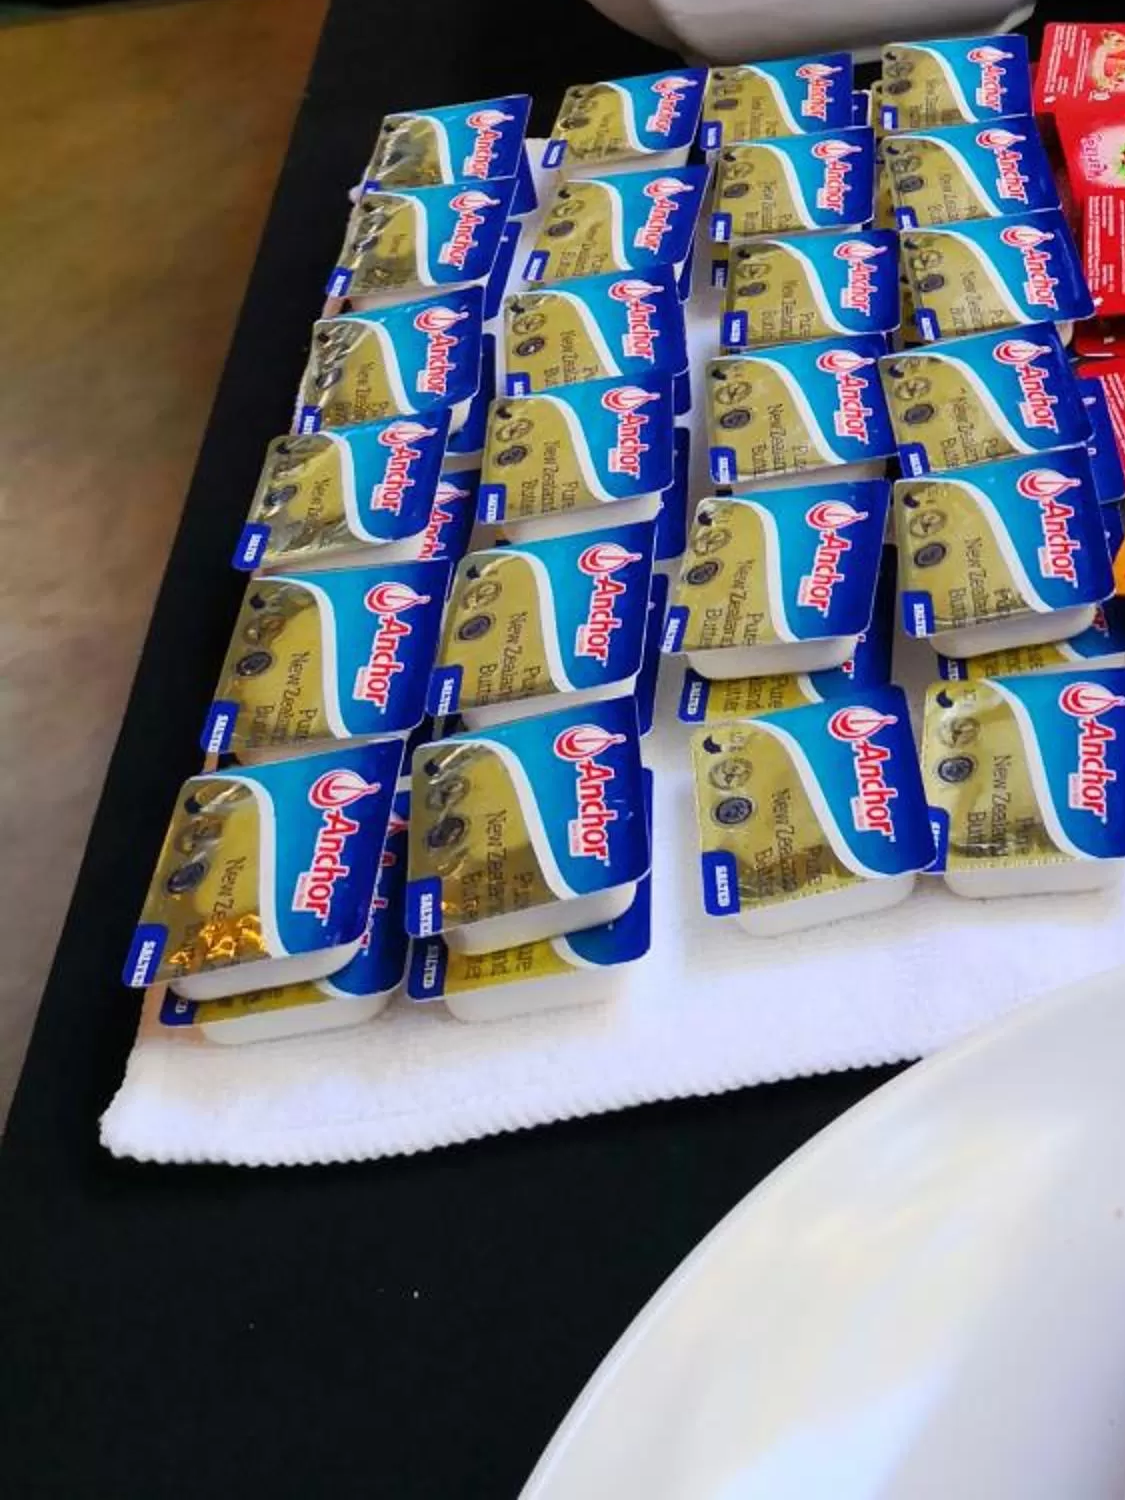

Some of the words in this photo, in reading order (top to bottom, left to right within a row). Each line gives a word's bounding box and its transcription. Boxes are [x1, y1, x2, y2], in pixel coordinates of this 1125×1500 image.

[826, 158, 852, 214] Anchor
[997, 148, 1029, 203] Anchor
[448, 211, 485, 269] Anchor
[645, 196, 678, 254] Anchor
[850, 260, 879, 315] Anchor
[1022, 247, 1059, 309] Anchor
[628, 300, 659, 363] Anchor
[427, 332, 458, 396] Anchor
[840, 373, 872, 443] Anchor
[1018, 362, 1058, 433] Anchor
[619, 411, 649, 479] Anchor
[381, 444, 421, 514] Anchor
[419, 508, 453, 560] Anch
[1041, 498, 1081, 584] Anchor
[809, 532, 852, 612] Anchor
[586, 575, 626, 661] Anchor
[287, 651, 311, 688] New
[366, 615, 412, 708] Anchor
[853, 740, 899, 838] Anchor
[992, 755, 1012, 789] New
[1080, 718, 1117, 819] Anchor
[486, 809, 508, 846] New
[577, 759, 619, 861] Anchor
[772, 788, 792, 825] New
[306, 808, 360, 920] Anchor
[715, 865, 731, 907] SALTED
